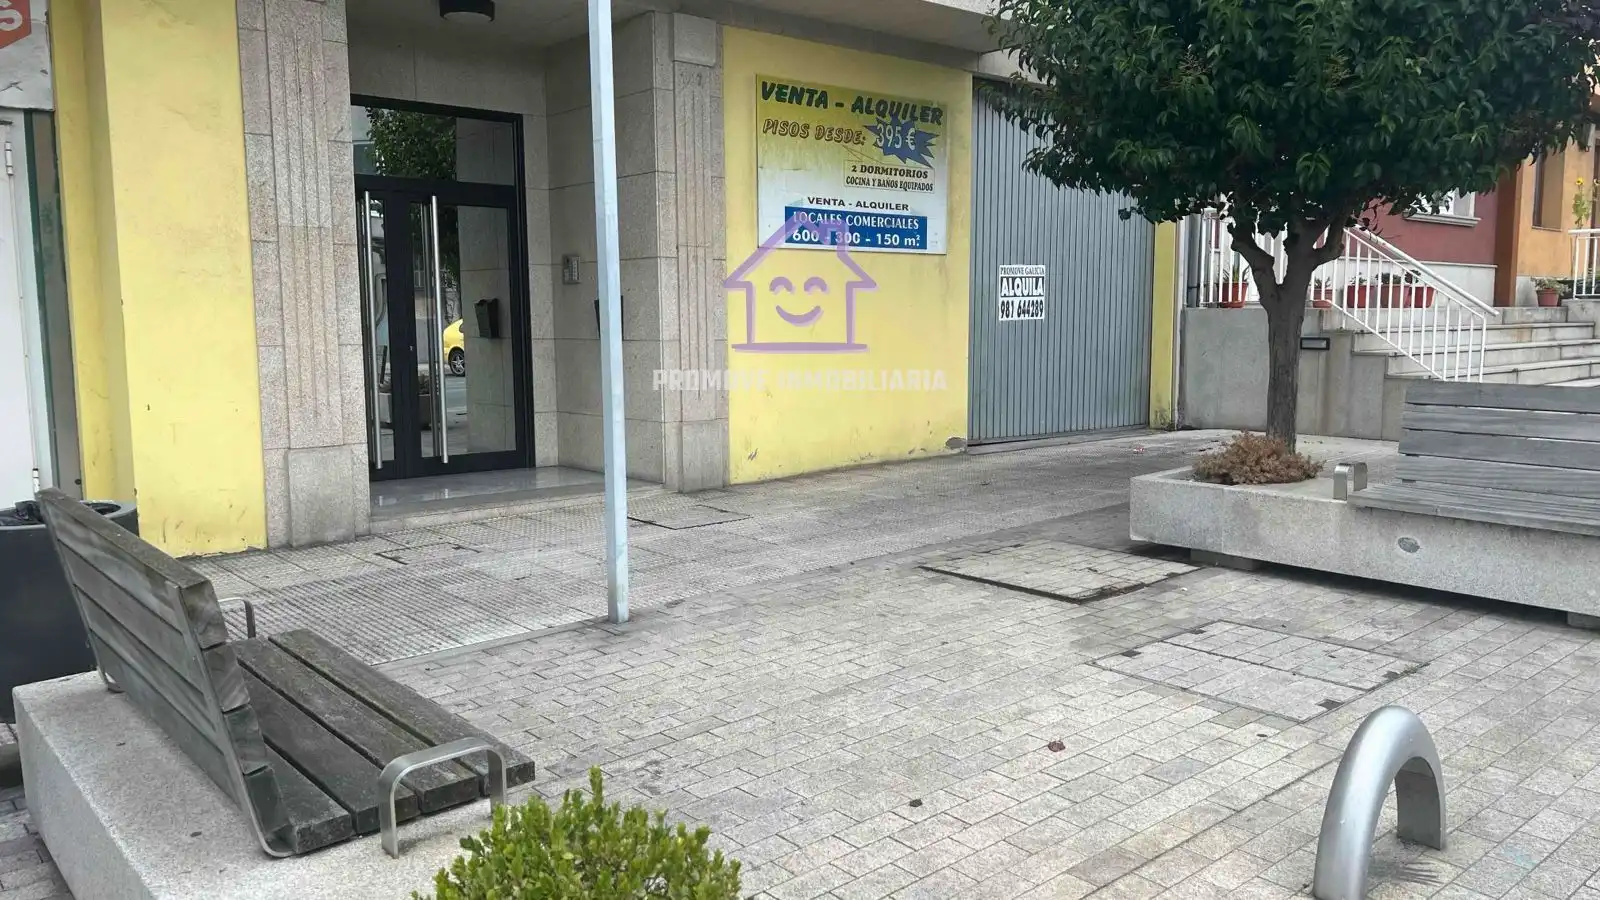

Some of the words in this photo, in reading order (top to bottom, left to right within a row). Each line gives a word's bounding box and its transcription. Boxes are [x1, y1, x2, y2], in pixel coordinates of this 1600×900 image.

[761, 81, 829, 109] VENTA
[851, 95, 943, 126] ALQUILER
[763, 119, 810, 139] PISOS
[815, 125, 867, 146] DESDE:
[876, 123, 901, 149] 395
[905, 127, 916, 151] €
[851, 165, 857, 173] 2
[860, 165, 928, 179] DORMITORIOS
[846, 176, 870, 187] COCINA
[871, 179, 877, 187] Y
[877, 178, 898, 189] BAÑOS
[900, 181, 933, 191] EQUIPADOS
[807, 196, 845, 207] VENTA
[856, 200, 909, 211] ALQUILER
[793, 211, 842, 225] LOCALES
[846, 215, 919, 230] COMERCIALES
[792, 229, 819, 242] 600
[835, 231, 860, 244] 300
[876, 233, 899, 245] 150
[1001, 277, 1043, 296] ALQUILA
[1001, 300, 1014, 318] 981
[1017, 299, 1043, 318] 644289
